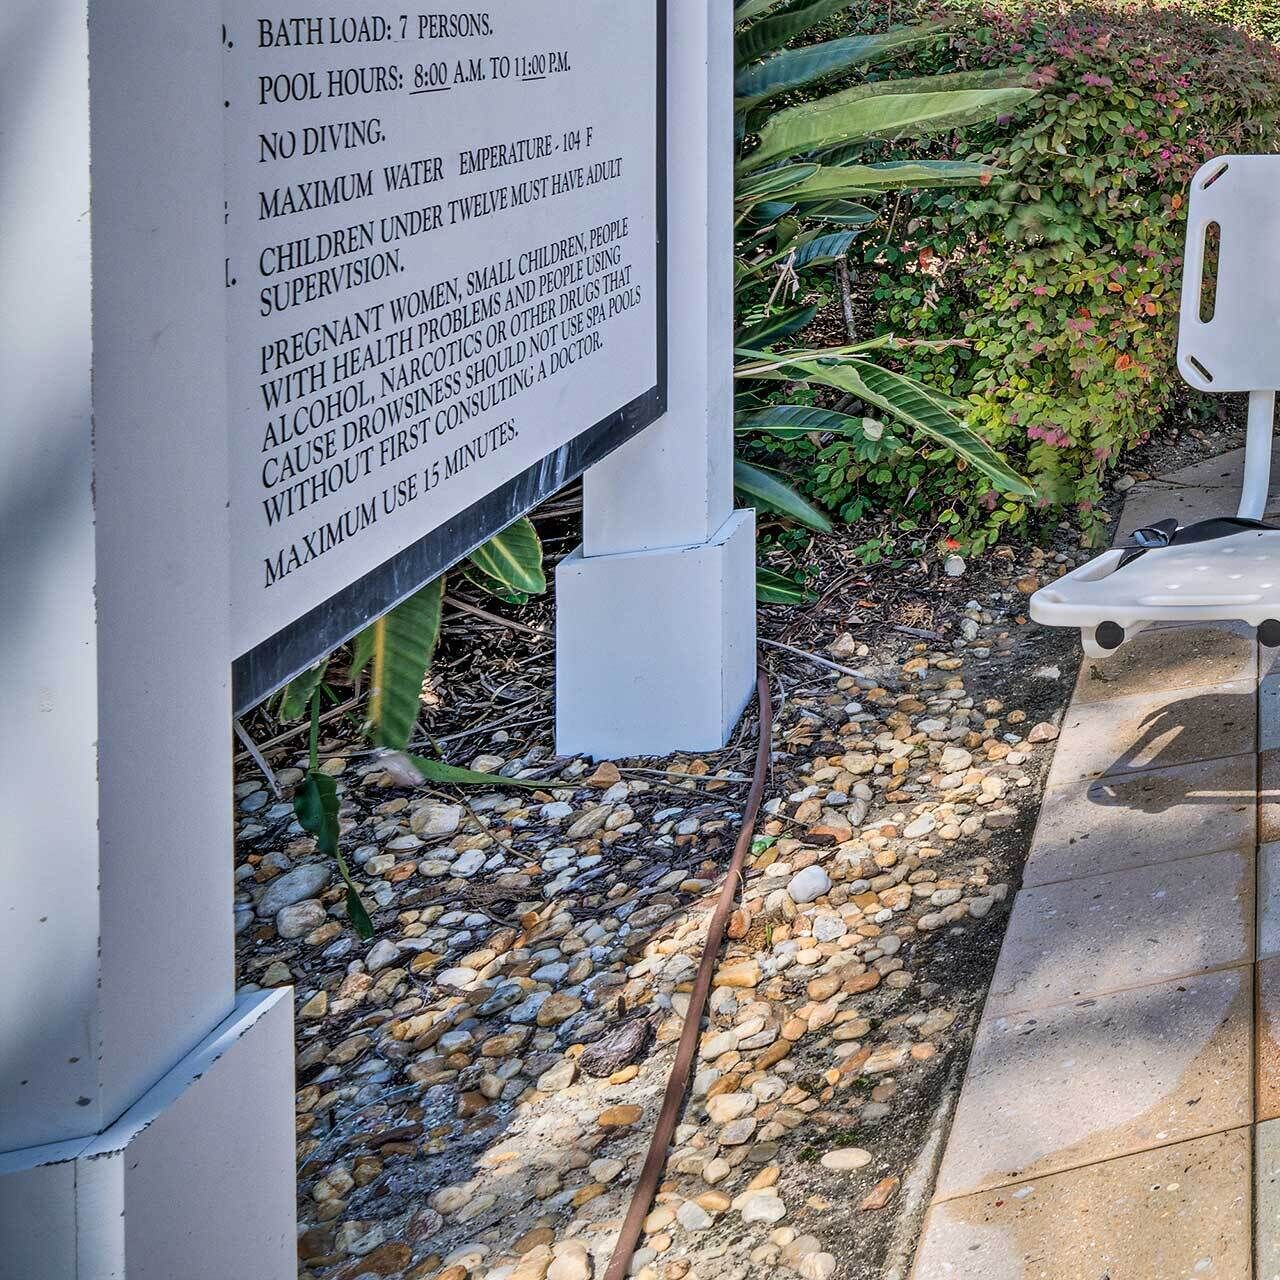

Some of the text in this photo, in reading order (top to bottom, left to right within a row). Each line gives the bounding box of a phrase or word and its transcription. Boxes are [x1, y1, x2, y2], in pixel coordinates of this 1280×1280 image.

[256, 16, 325, 49] BATH
[328, 15, 392, 45] LOAD:
[398, 14, 408, 40] 7
[417, 12, 494, 40] PERSONS.
[257, 50, 572, 106] POOL HOURS: 8:00 A.M. TO 11:00 P.M.
[258, 117, 386, 164] NO DIVING.
[258, 169, 374, 221] MAXIMUM
[382, 156, 445, 192] WATER
[562, 129, 581, 153] 104
[585, 126, 594, 148] F
[259, 219, 375, 278] CHILDREN
[380, 204, 444, 244] UNDER
[447, 186, 509, 225] TWELVE
[510, 176, 550, 208] MUST
[550, 167, 585, 196] HAVE
[585, 156, 623, 187] ADULT
[259, 247, 405, 318] SUPERVISION.
[259, 244, 622, 412] WITH HEALTH PROBLEMS AND PEOPLE USING
[260, 216, 629, 376] PREGNANT WOMEN, SMALL CHILDREN, PEOPLE
[379, 329, 483, 399] NARCOTICS
[485, 319, 508, 349] OR
[509, 297, 557, 338] OTHER
[559, 278, 601, 316] DRUGS
[601, 263, 632, 296] THAT
[261, 284, 642, 489] CAUSE DROWSINESS SHOULD NOT USE SPA POOLS
[261, 330, 604, 527] WITHOUT FIRST CONSULTING A DOCTOR.
[263, 417, 519, 589] MAXIMUM USE 15 MINUTES.
